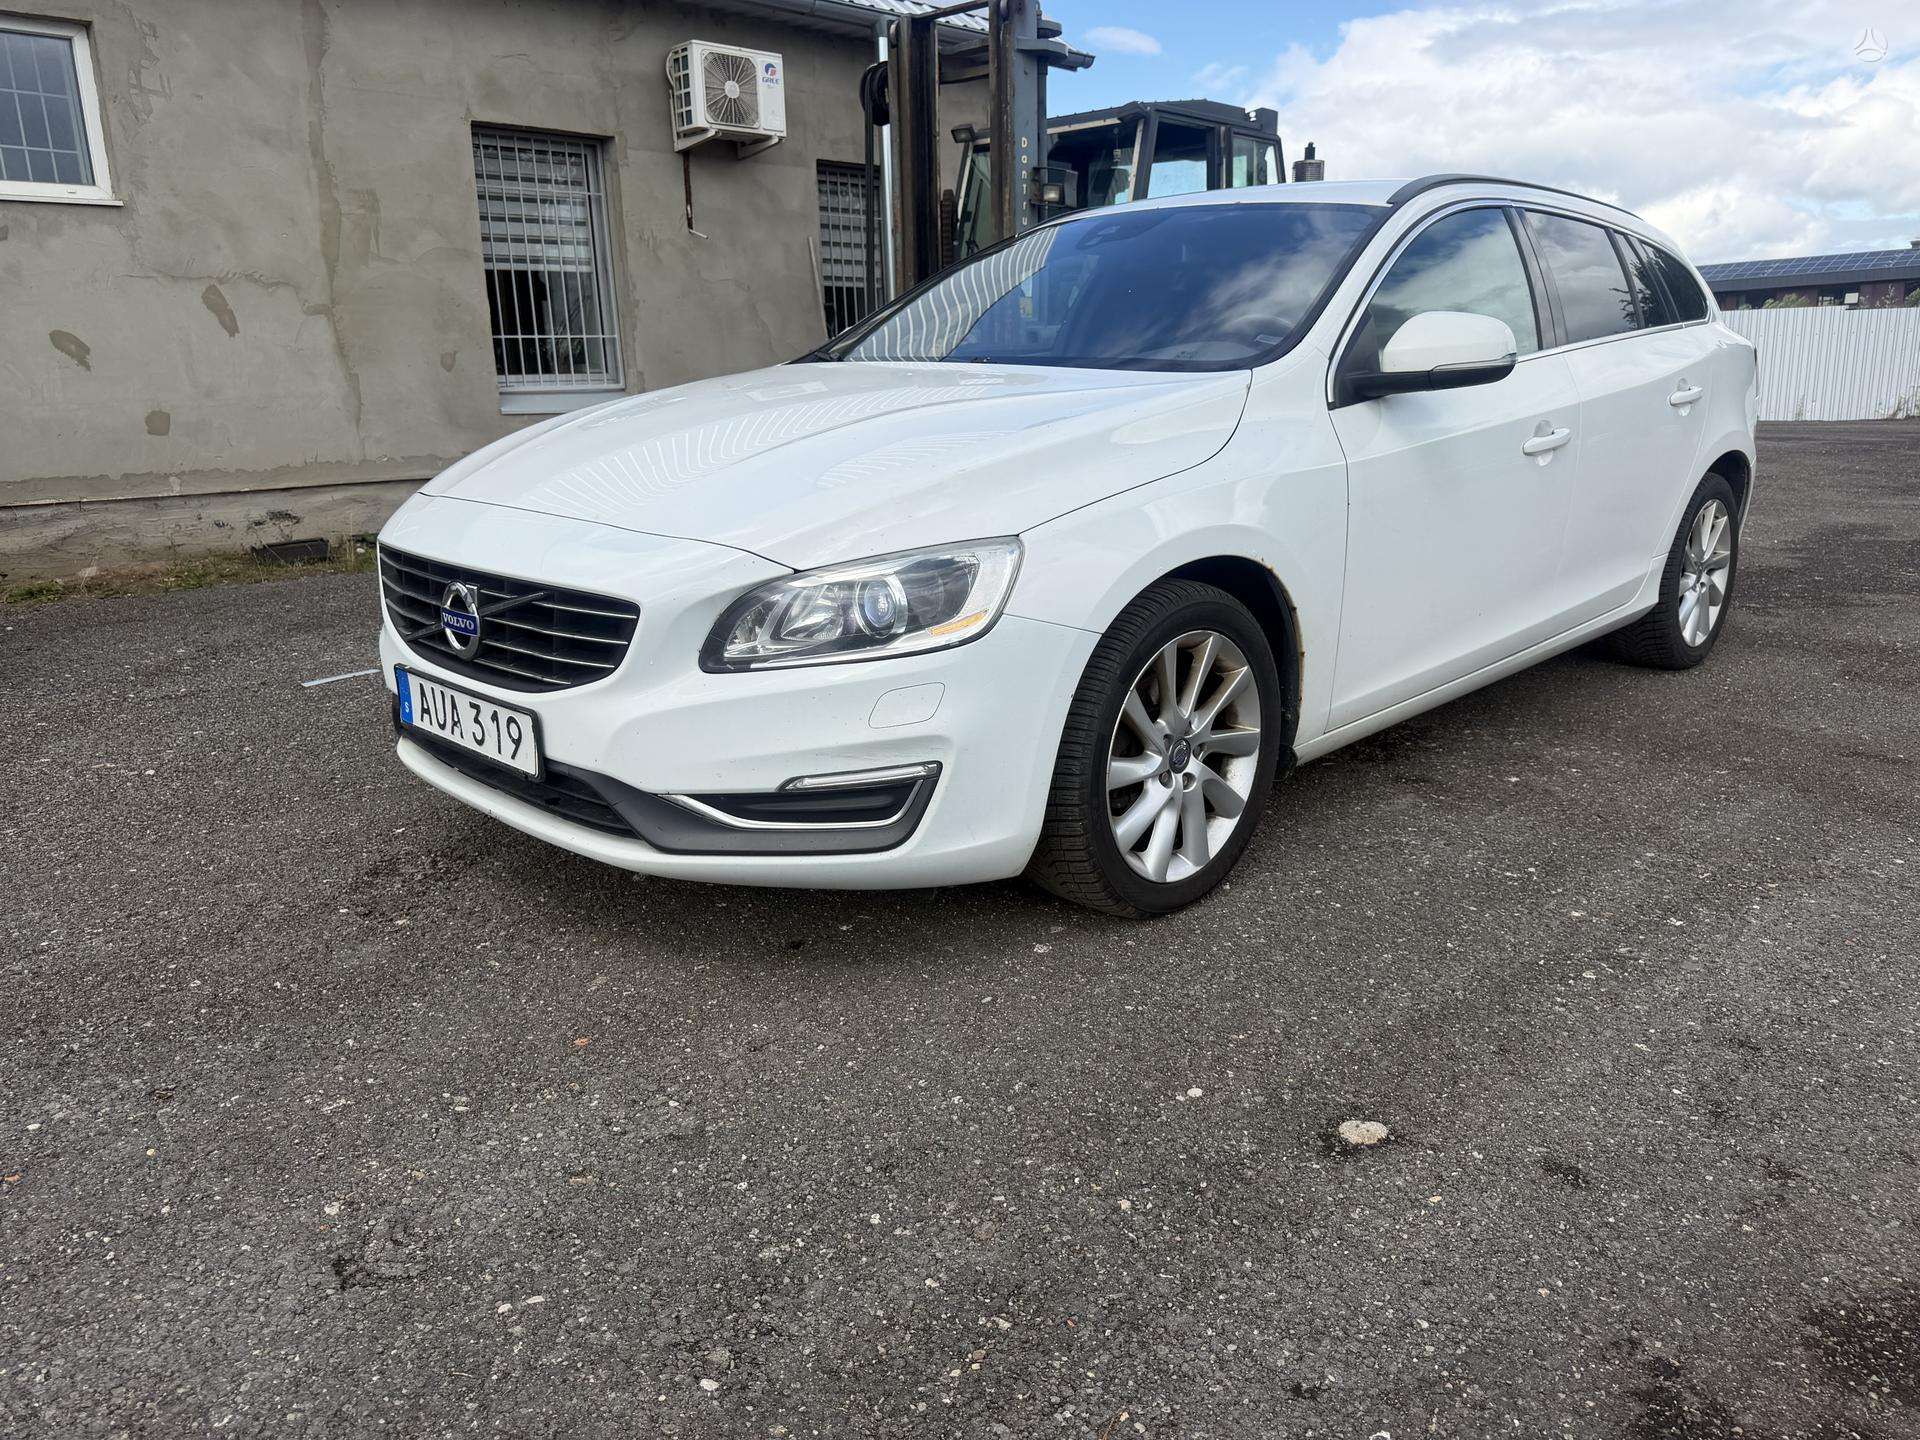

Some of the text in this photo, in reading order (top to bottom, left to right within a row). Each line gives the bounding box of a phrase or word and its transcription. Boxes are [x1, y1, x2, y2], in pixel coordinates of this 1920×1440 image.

[442, 612, 475, 630] VOLVO
[404, 702, 409, 713] S
[419, 682, 522, 760] AUA 319
